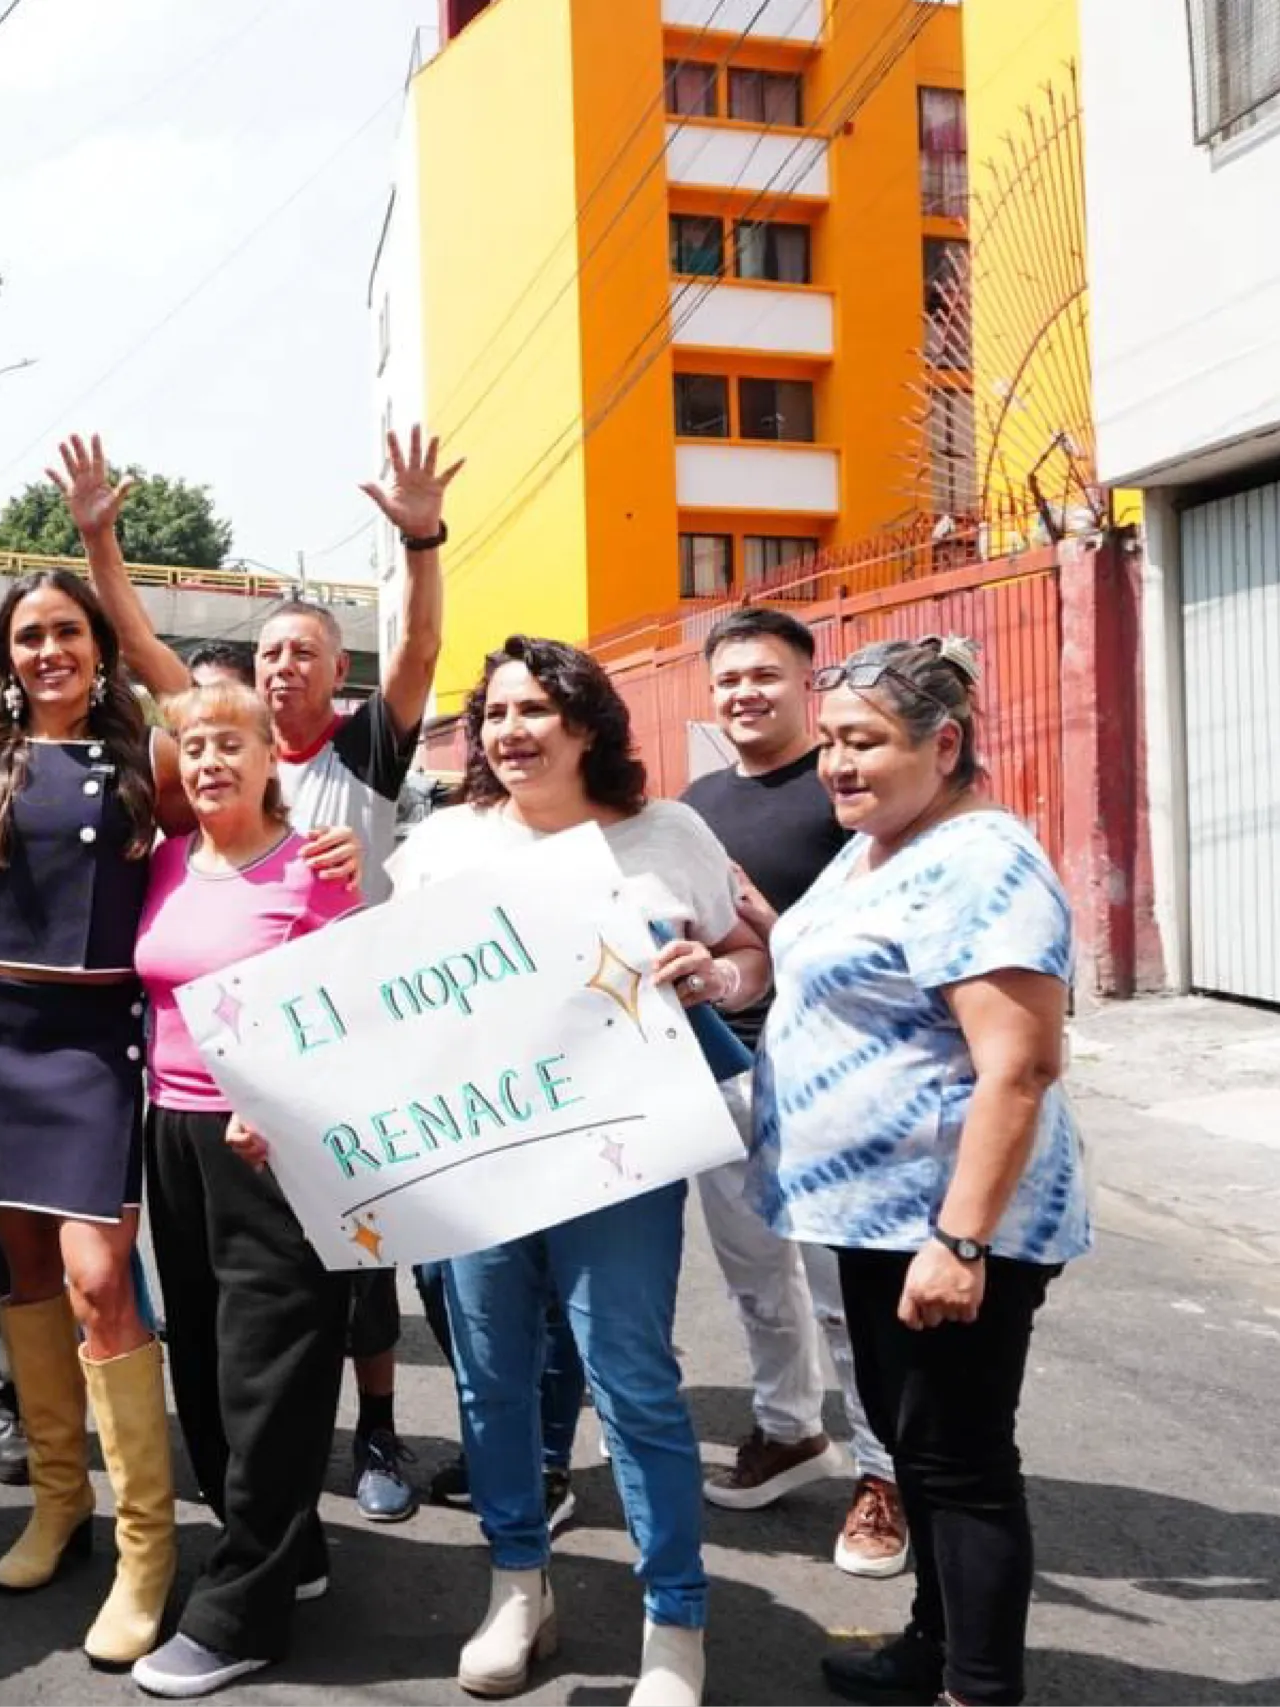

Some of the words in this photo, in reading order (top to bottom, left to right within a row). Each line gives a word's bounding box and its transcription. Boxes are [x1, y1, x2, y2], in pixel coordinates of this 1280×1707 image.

[281, 985, 348, 1055] El
[380, 905, 537, 1021] nopal
[322, 1053, 586, 1179] RENACE
